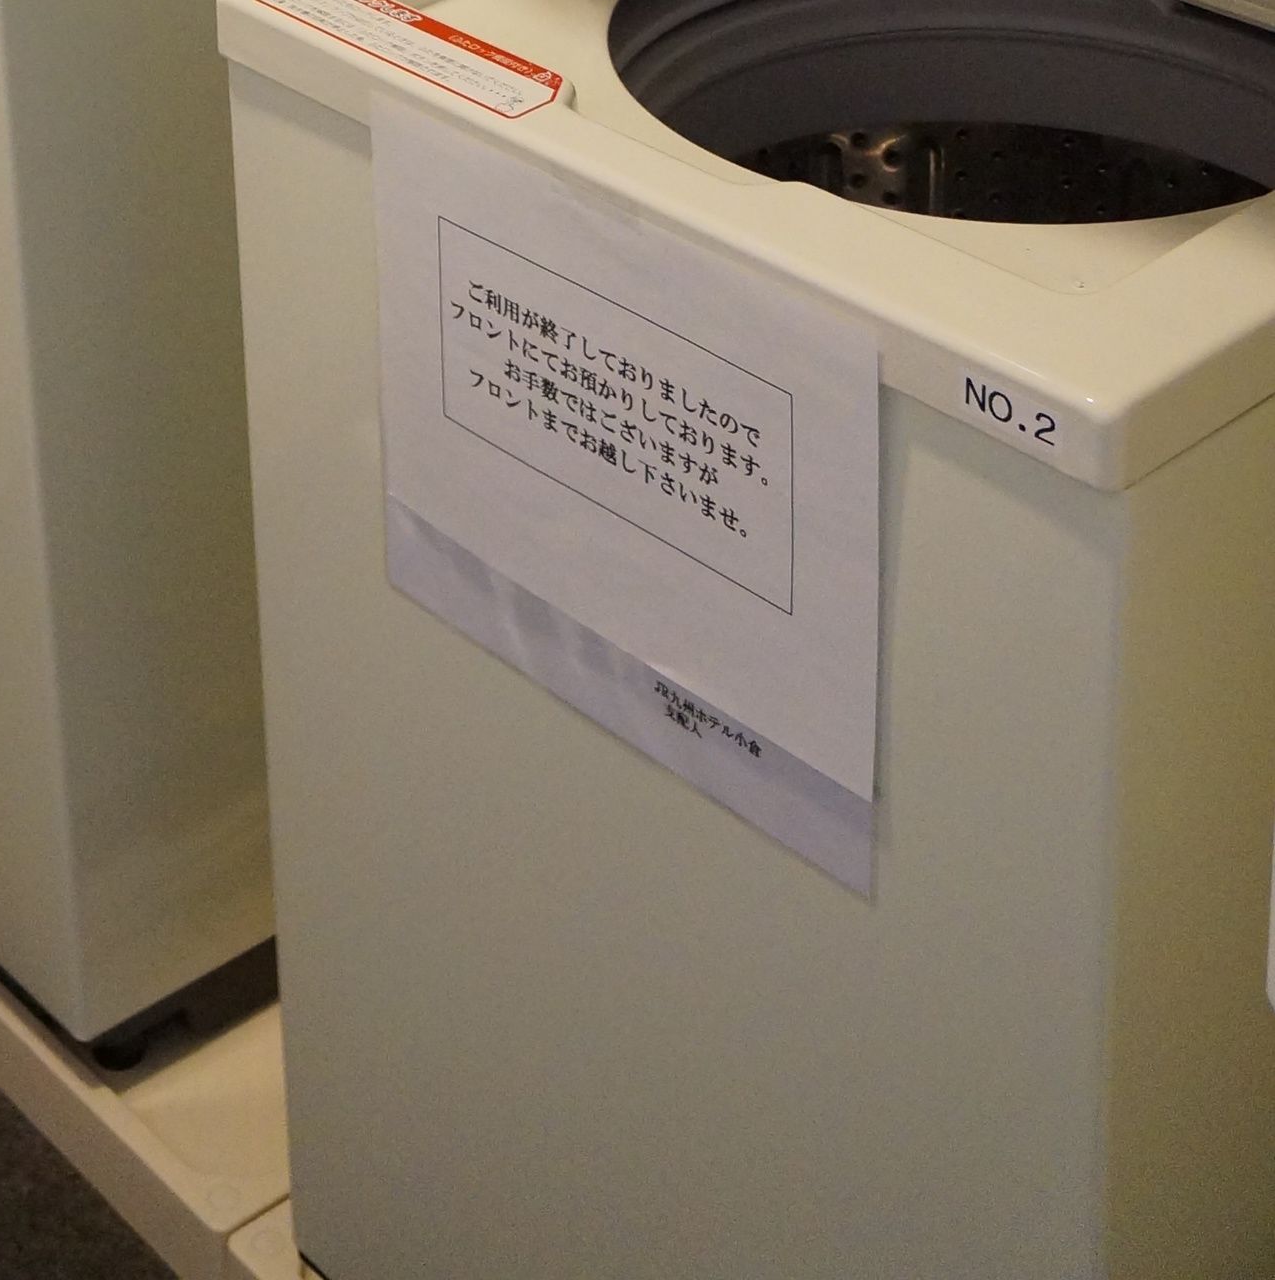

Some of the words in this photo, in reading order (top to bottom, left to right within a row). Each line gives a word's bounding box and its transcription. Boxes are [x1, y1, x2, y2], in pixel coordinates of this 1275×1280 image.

[450, 300, 769, 487] フロントにてお預かりしております。
[468, 280, 761, 447] ご利用が終了しておりましたので
[504, 358, 719, 485] お手数ではございますが
[965, 376, 1056, 446] NO.2
[469, 368, 747, 539] フロントまでお越し下さいませ。
[654, 680, 762, 758] JR九州ホテル小倉
[665, 704, 702, 738] 支配人
